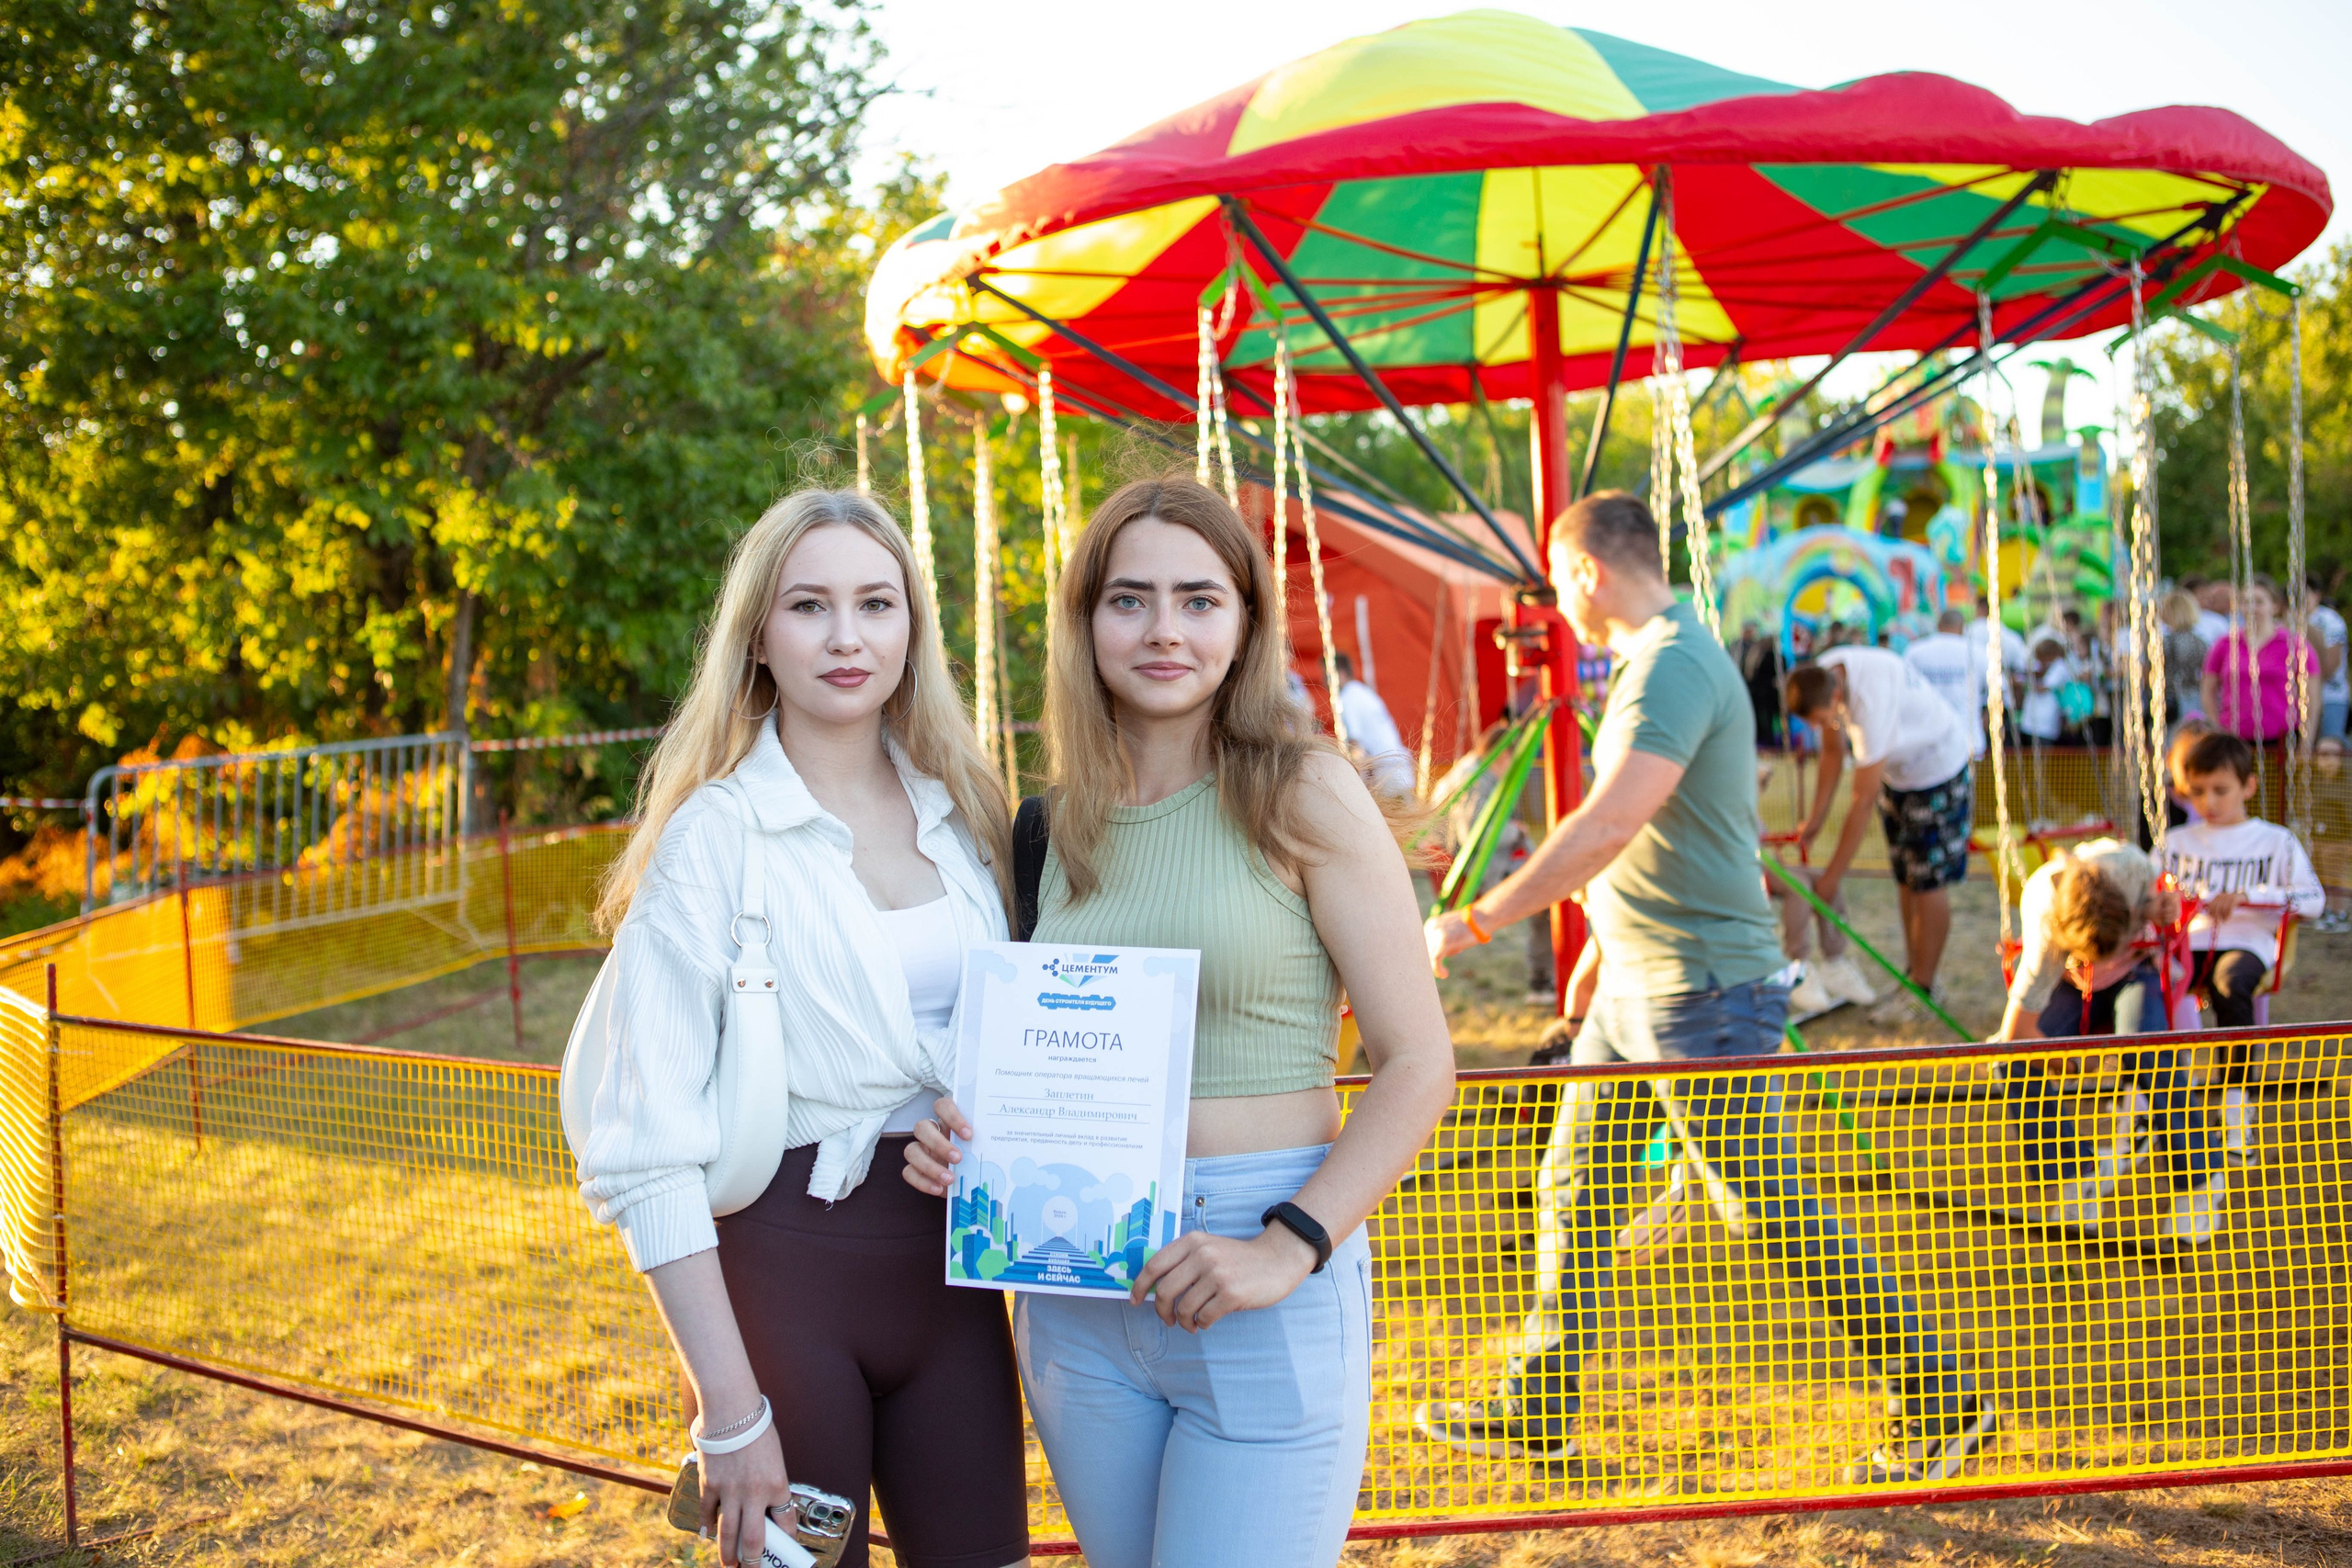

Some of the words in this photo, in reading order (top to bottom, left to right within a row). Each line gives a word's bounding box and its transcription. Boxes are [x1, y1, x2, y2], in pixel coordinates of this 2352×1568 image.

[1061, 964, 1118, 975] ЦЕМЕНТУМ
[1023, 1028, 1123, 1051] ГРАМОТА
[1047, 1055, 1097, 1064] награждается
[995, 1068, 1033, 1078] Помощник
[1035, 1071, 1072, 1080] оператора
[1074, 1073, 1125, 1082] вращающихся
[1127, 1075, 1149, 1083] печей
[1044, 1088, 1094, 1100] Заплетин
[999, 1103, 1056, 1118] Александр
[1058, 1106, 1137, 1122] Владимирович
[1014, 1130, 1054, 1138] значительный
[1046, 1265, 1071, 1273] ЗДЕСЬ
[1037, 1272, 1045, 1280] И
[1046, 1273, 1080, 1283] СЕЙЧАС
